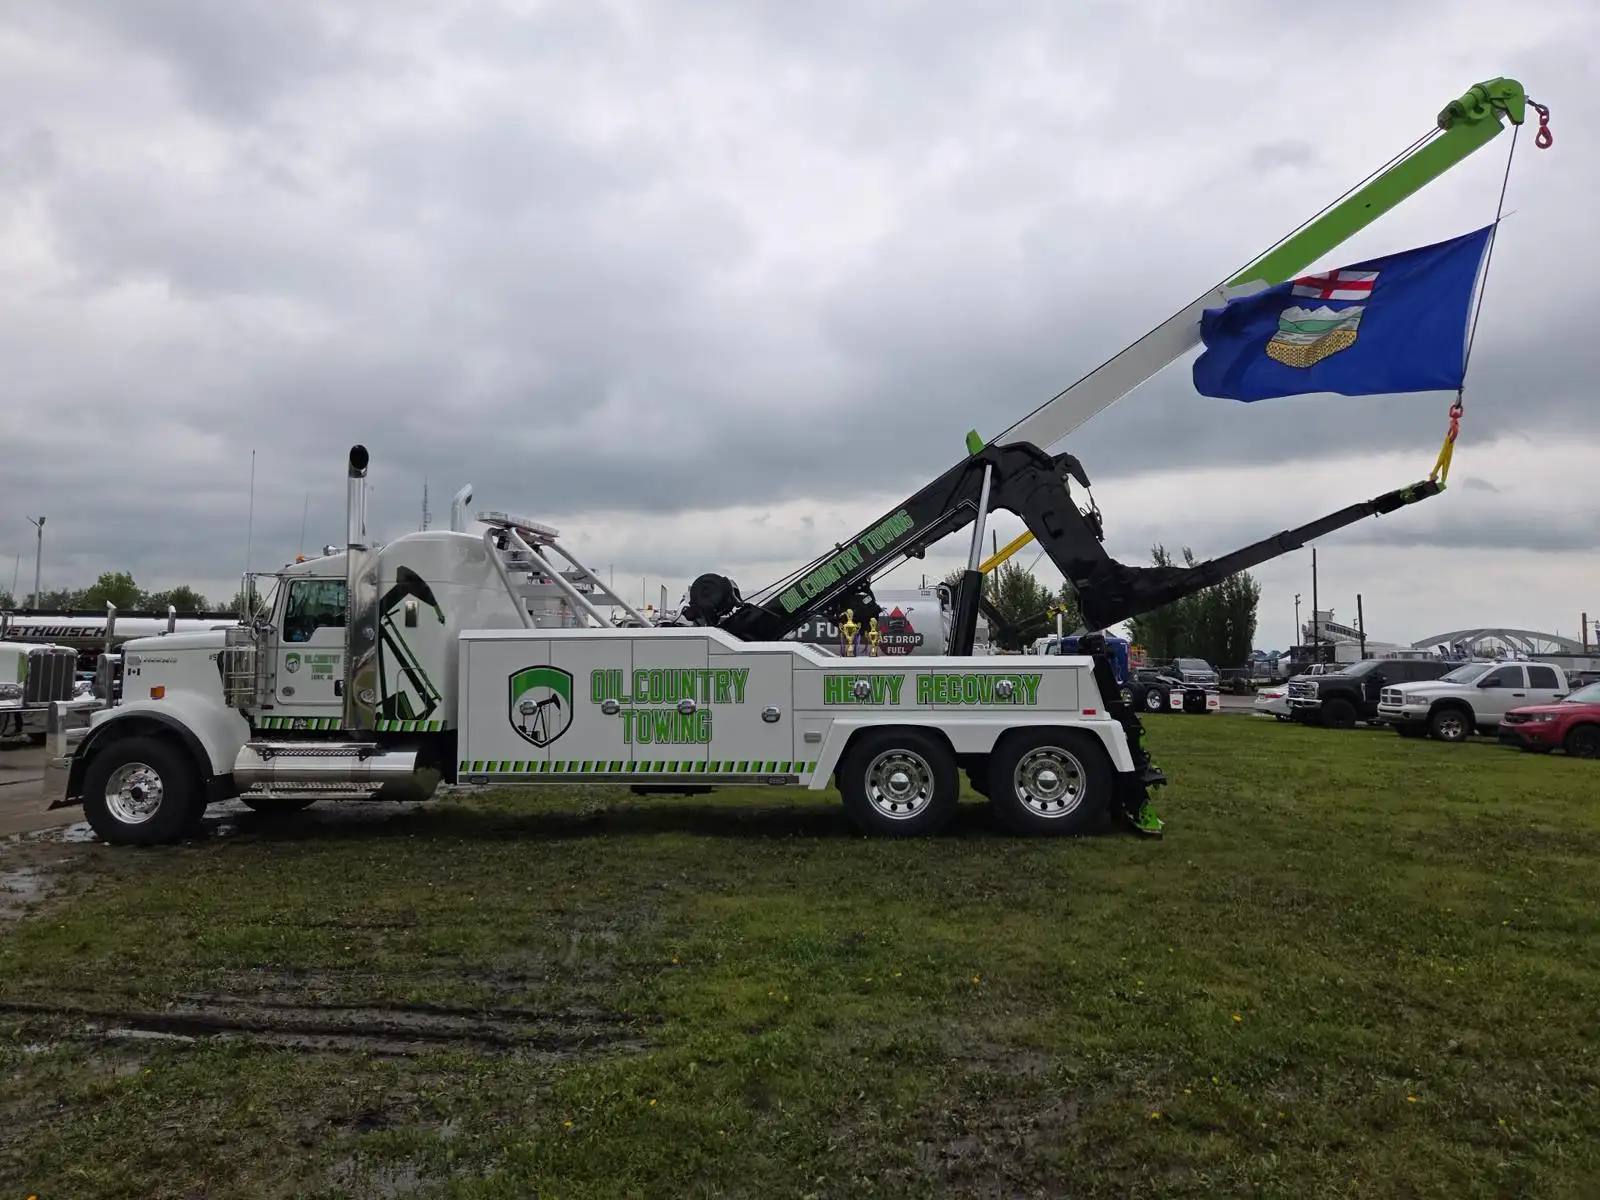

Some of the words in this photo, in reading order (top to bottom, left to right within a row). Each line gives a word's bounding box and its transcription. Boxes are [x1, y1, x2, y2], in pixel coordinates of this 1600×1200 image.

[779, 586, 809, 613] OIL
[800, 543, 864, 598] COUNTRY
[859, 508, 915, 555] TOWING
[6, 625, 108, 637] ETHWISCH
[896, 635, 921, 644] DROP
[887, 646, 907, 654] FUEL
[590, 669, 632, 704] OIL
[633, 668, 749, 704] COUNTRY
[824, 674, 906, 705] HEAVY
[619, 709, 713, 744] TOWING
